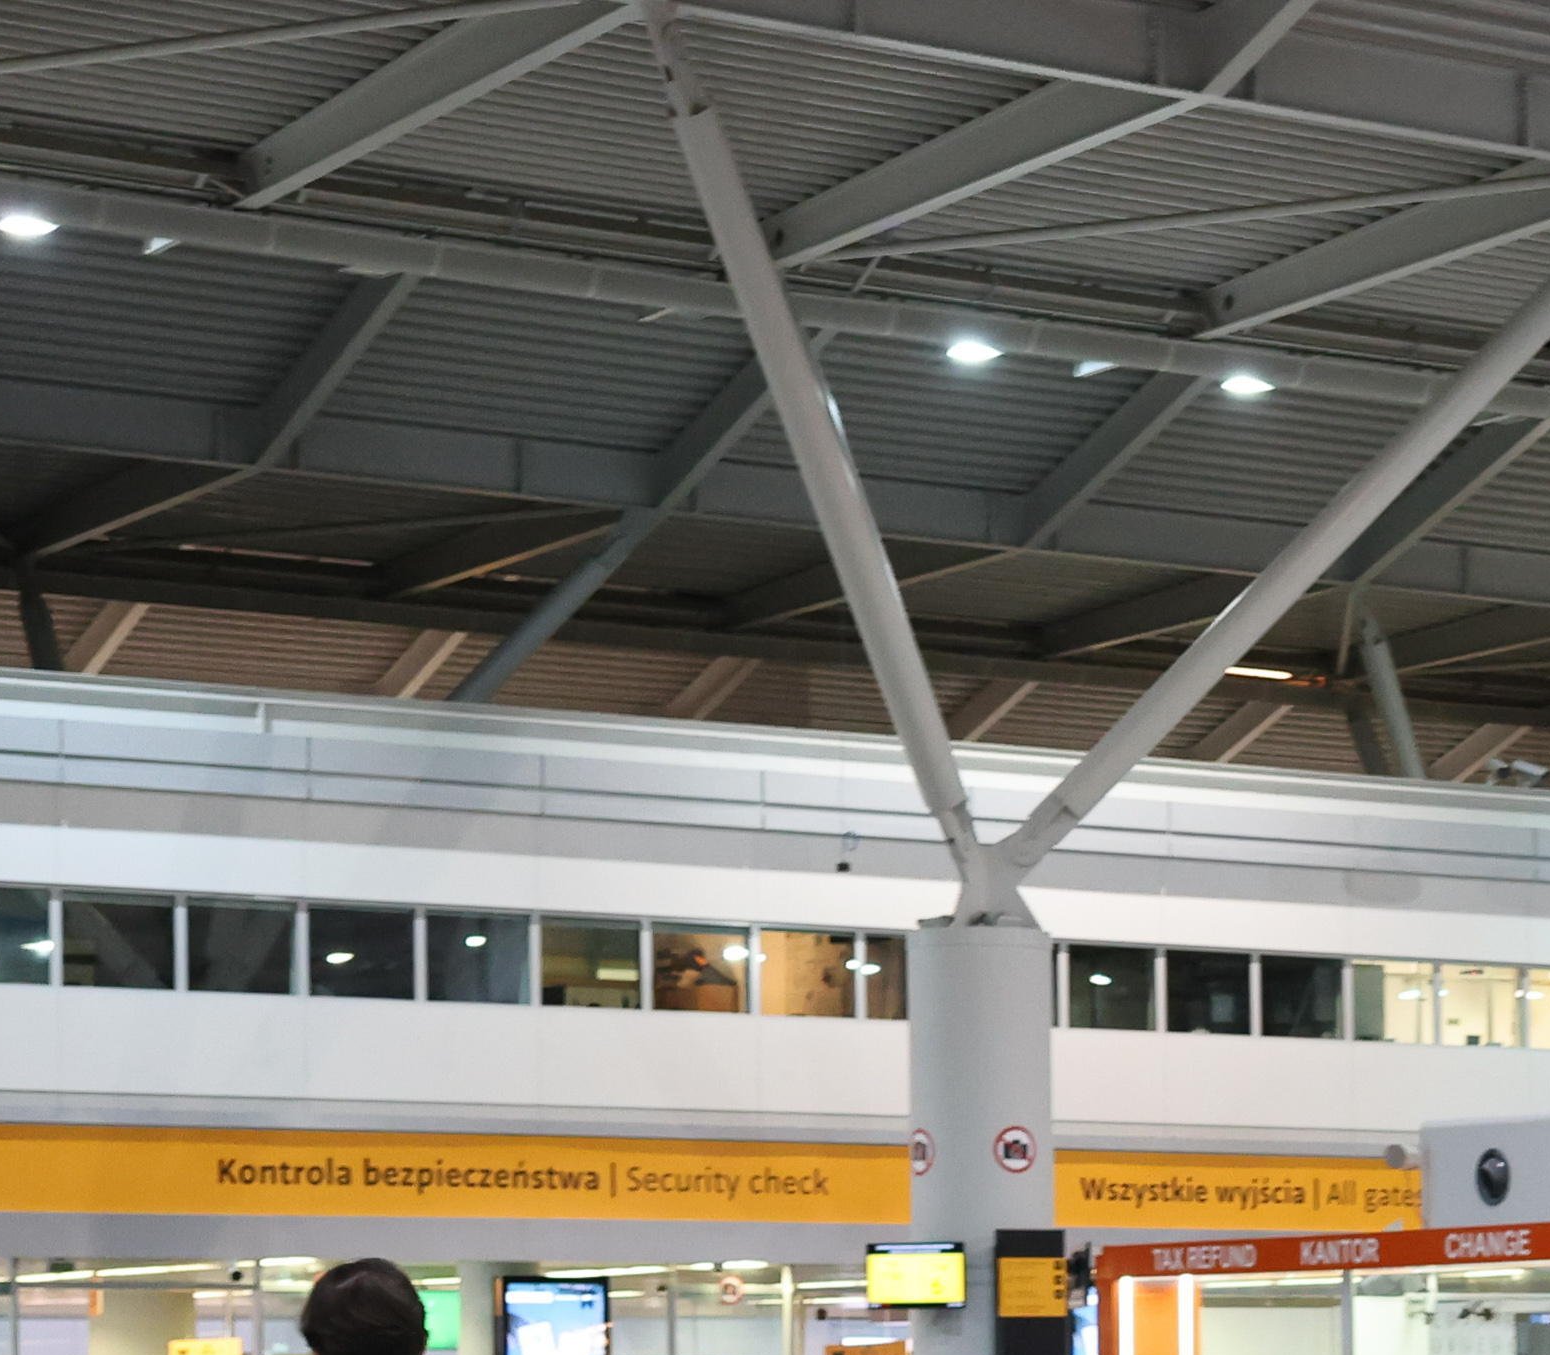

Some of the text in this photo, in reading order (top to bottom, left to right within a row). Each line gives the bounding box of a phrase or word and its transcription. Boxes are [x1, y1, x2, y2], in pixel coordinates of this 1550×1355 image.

[218, 1157, 830, 1202] Kontrola bezpieczeństwa Security check
[1080, 1177, 1208, 1208] Wszystkie
[1215, 1178, 1305, 1210] wyjścia
[1327, 1180, 1356, 1205] All
[1152, 1243, 1258, 1271] TAX REFUND
[1299, 1237, 1380, 1265] KANTOR
[1444, 1228, 1532, 1258] CHANGE
